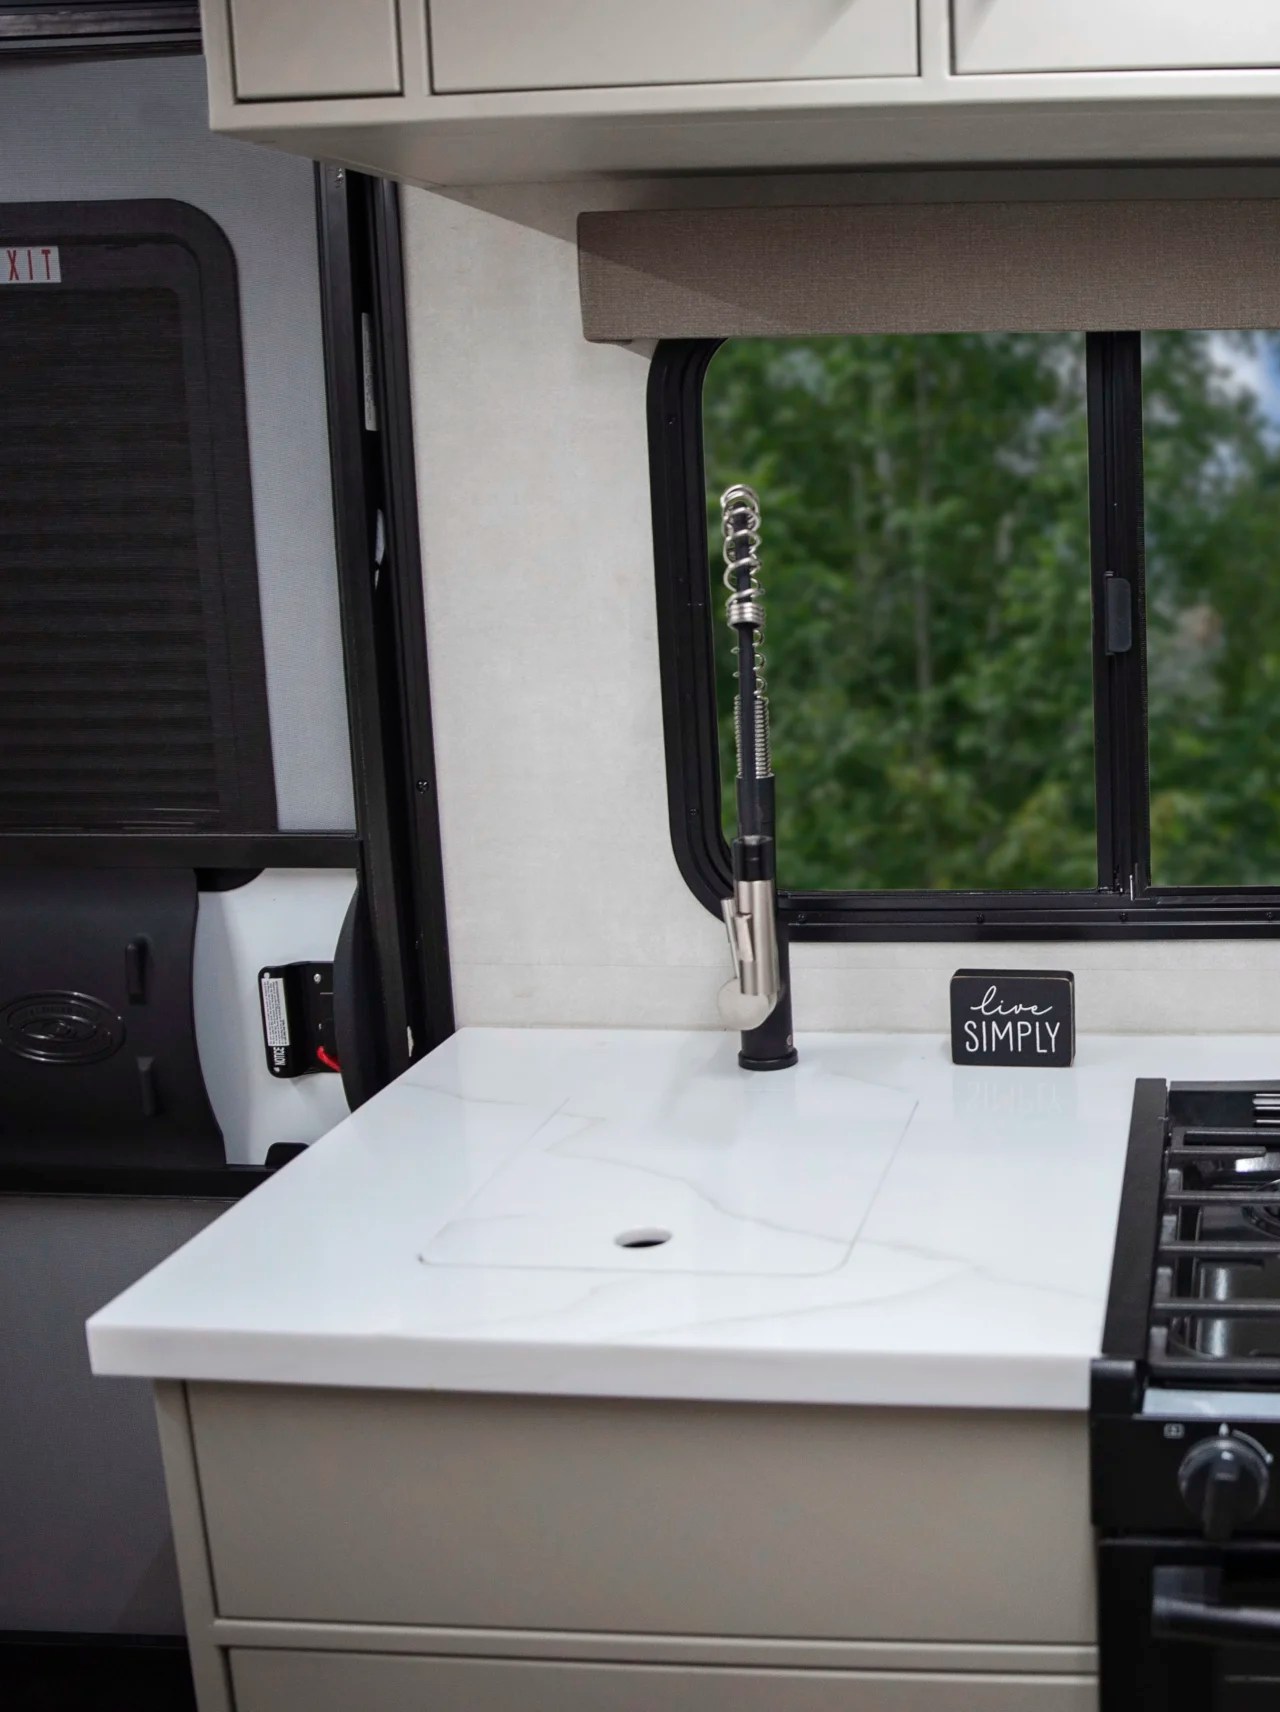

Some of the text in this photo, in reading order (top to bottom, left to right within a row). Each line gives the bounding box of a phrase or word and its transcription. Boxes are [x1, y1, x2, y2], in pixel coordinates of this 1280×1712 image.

[970, 985, 1053, 1015] live
[964, 1020, 1060, 1053] SIMPLY
[273, 1046, 286, 1066] NOTICE
